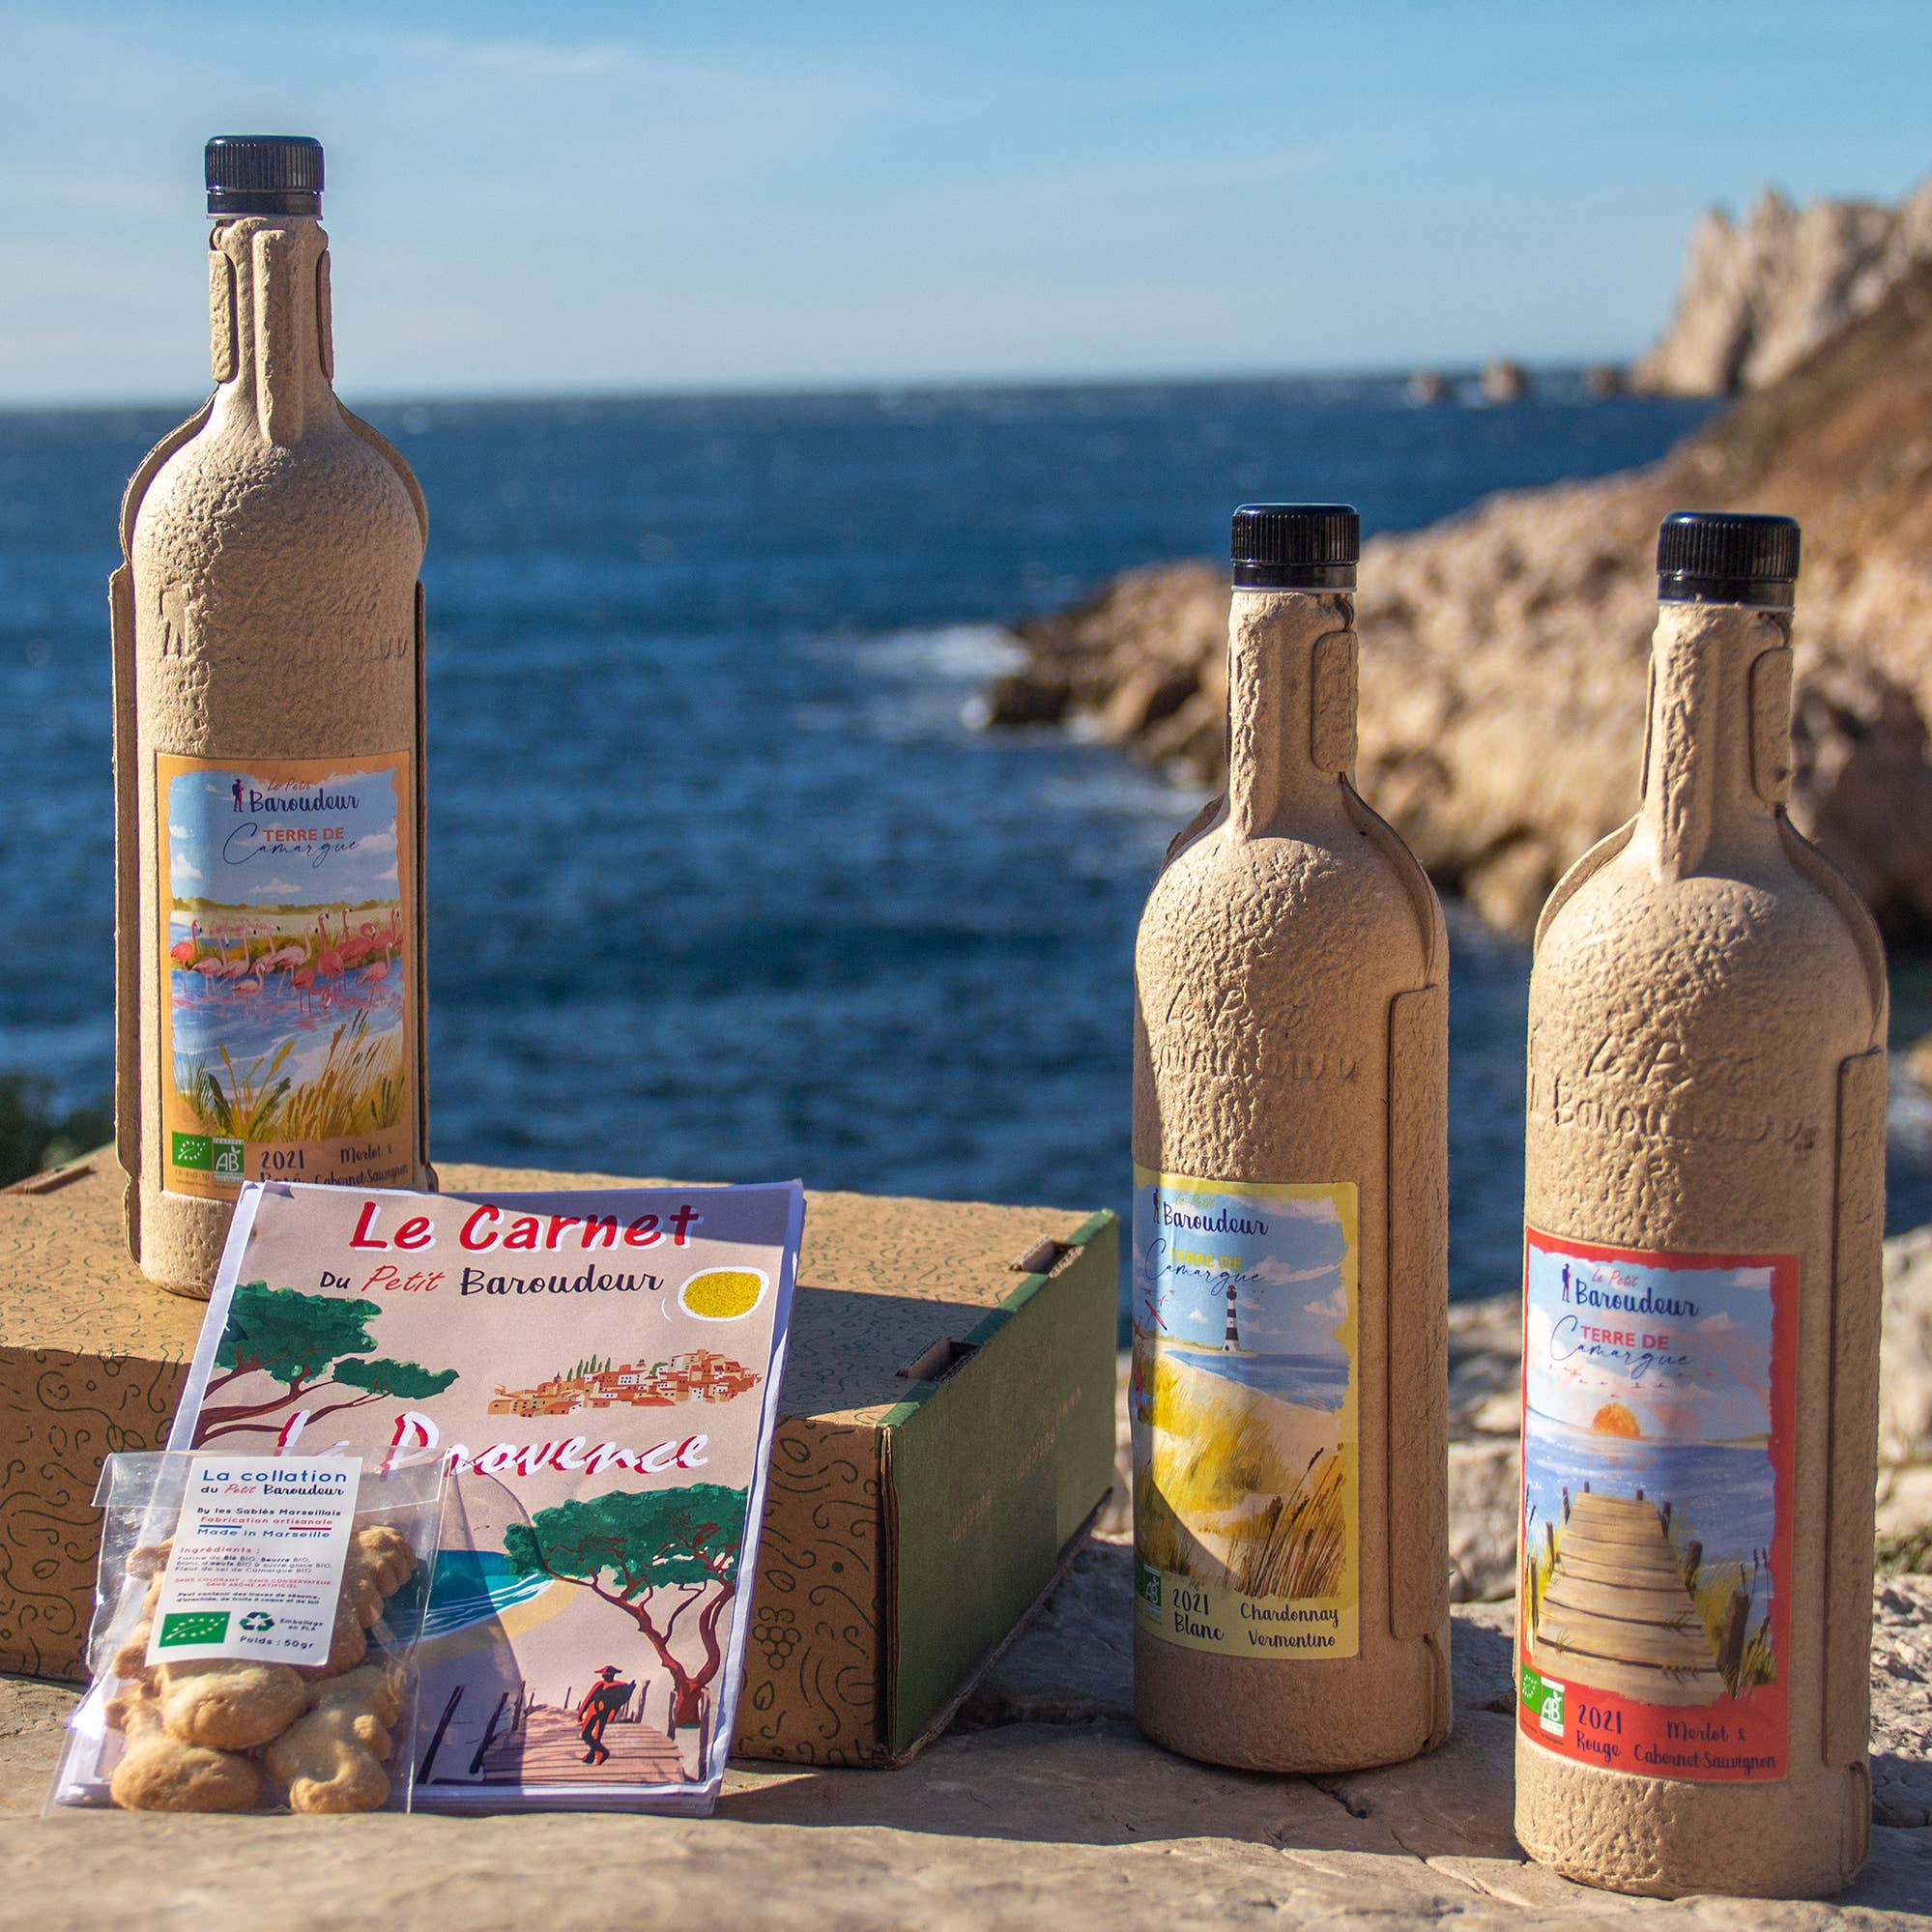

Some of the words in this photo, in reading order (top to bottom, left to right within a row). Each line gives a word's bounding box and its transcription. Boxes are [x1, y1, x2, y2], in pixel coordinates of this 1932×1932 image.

[249, 789, 360, 813] Baroudeur
[223, 822, 360, 868] Camargue
[263, 828, 318, 842] TERRE
[323, 827, 344, 840] DE
[215, 1152, 240, 1172] AB
[260, 1148, 305, 1170] 2021
[340, 1144, 383, 1165] Merlot
[349, 1201, 435, 1253] Le
[459, 1203, 703, 1253] Carnet
[1163, 1201, 1268, 1236] Baroudeur
[1144, 1238, 1267, 1296] Camargue
[1169, 1249, 1213, 1268] TERRE
[1219, 1255, 1244, 1271] DE
[320, 1270, 350, 1289] Du
[361, 1264, 446, 1293] Petit
[460, 1263, 664, 1296] Baroudeur
[1592, 1268, 1603, 1283] Le
[1609, 1269, 1638, 1287] Petit
[1575, 1278, 1700, 1317] Baroudeur
[1550, 1314, 1694, 1380] Camargue
[1580, 1325, 1635, 1347] TERRE
[1642, 1334, 1669, 1350] DE
[380, 1410, 709, 1480] Provence
[203, 1470, 230, 1482] La
[241, 1470, 347, 1483] collation
[224, 1484, 257, 1494] Petit
[264, 1484, 344, 1496] Baroudeur
[200, 1515, 269, 1524] Fabrication
[274, 1516, 332, 1525] artisanale
[278, 1508, 341, 1516] Marseillais
[263, 1530, 331, 1539] Marseille
[1172, 1588, 1209, 1615] 2021
[1174, 1611, 1225, 1641] Blanc
[1240, 1601, 1340, 1629] Chardonnay
[240, 1635, 273, 1645] Poids
[284, 1639, 314, 1650] 50gr
[1248, 1629, 1336, 1649] Vermentino
[1541, 1697, 1561, 1722] AB
[1577, 1704, 1622, 1735] 2021
[1666, 1721, 1728, 1743] Merlot
[1576, 1730, 1621, 1764] Rouge
[1634, 1744, 1700, 1768] Cabernet
[1704, 1750, 1777, 1775] Sauvignon
